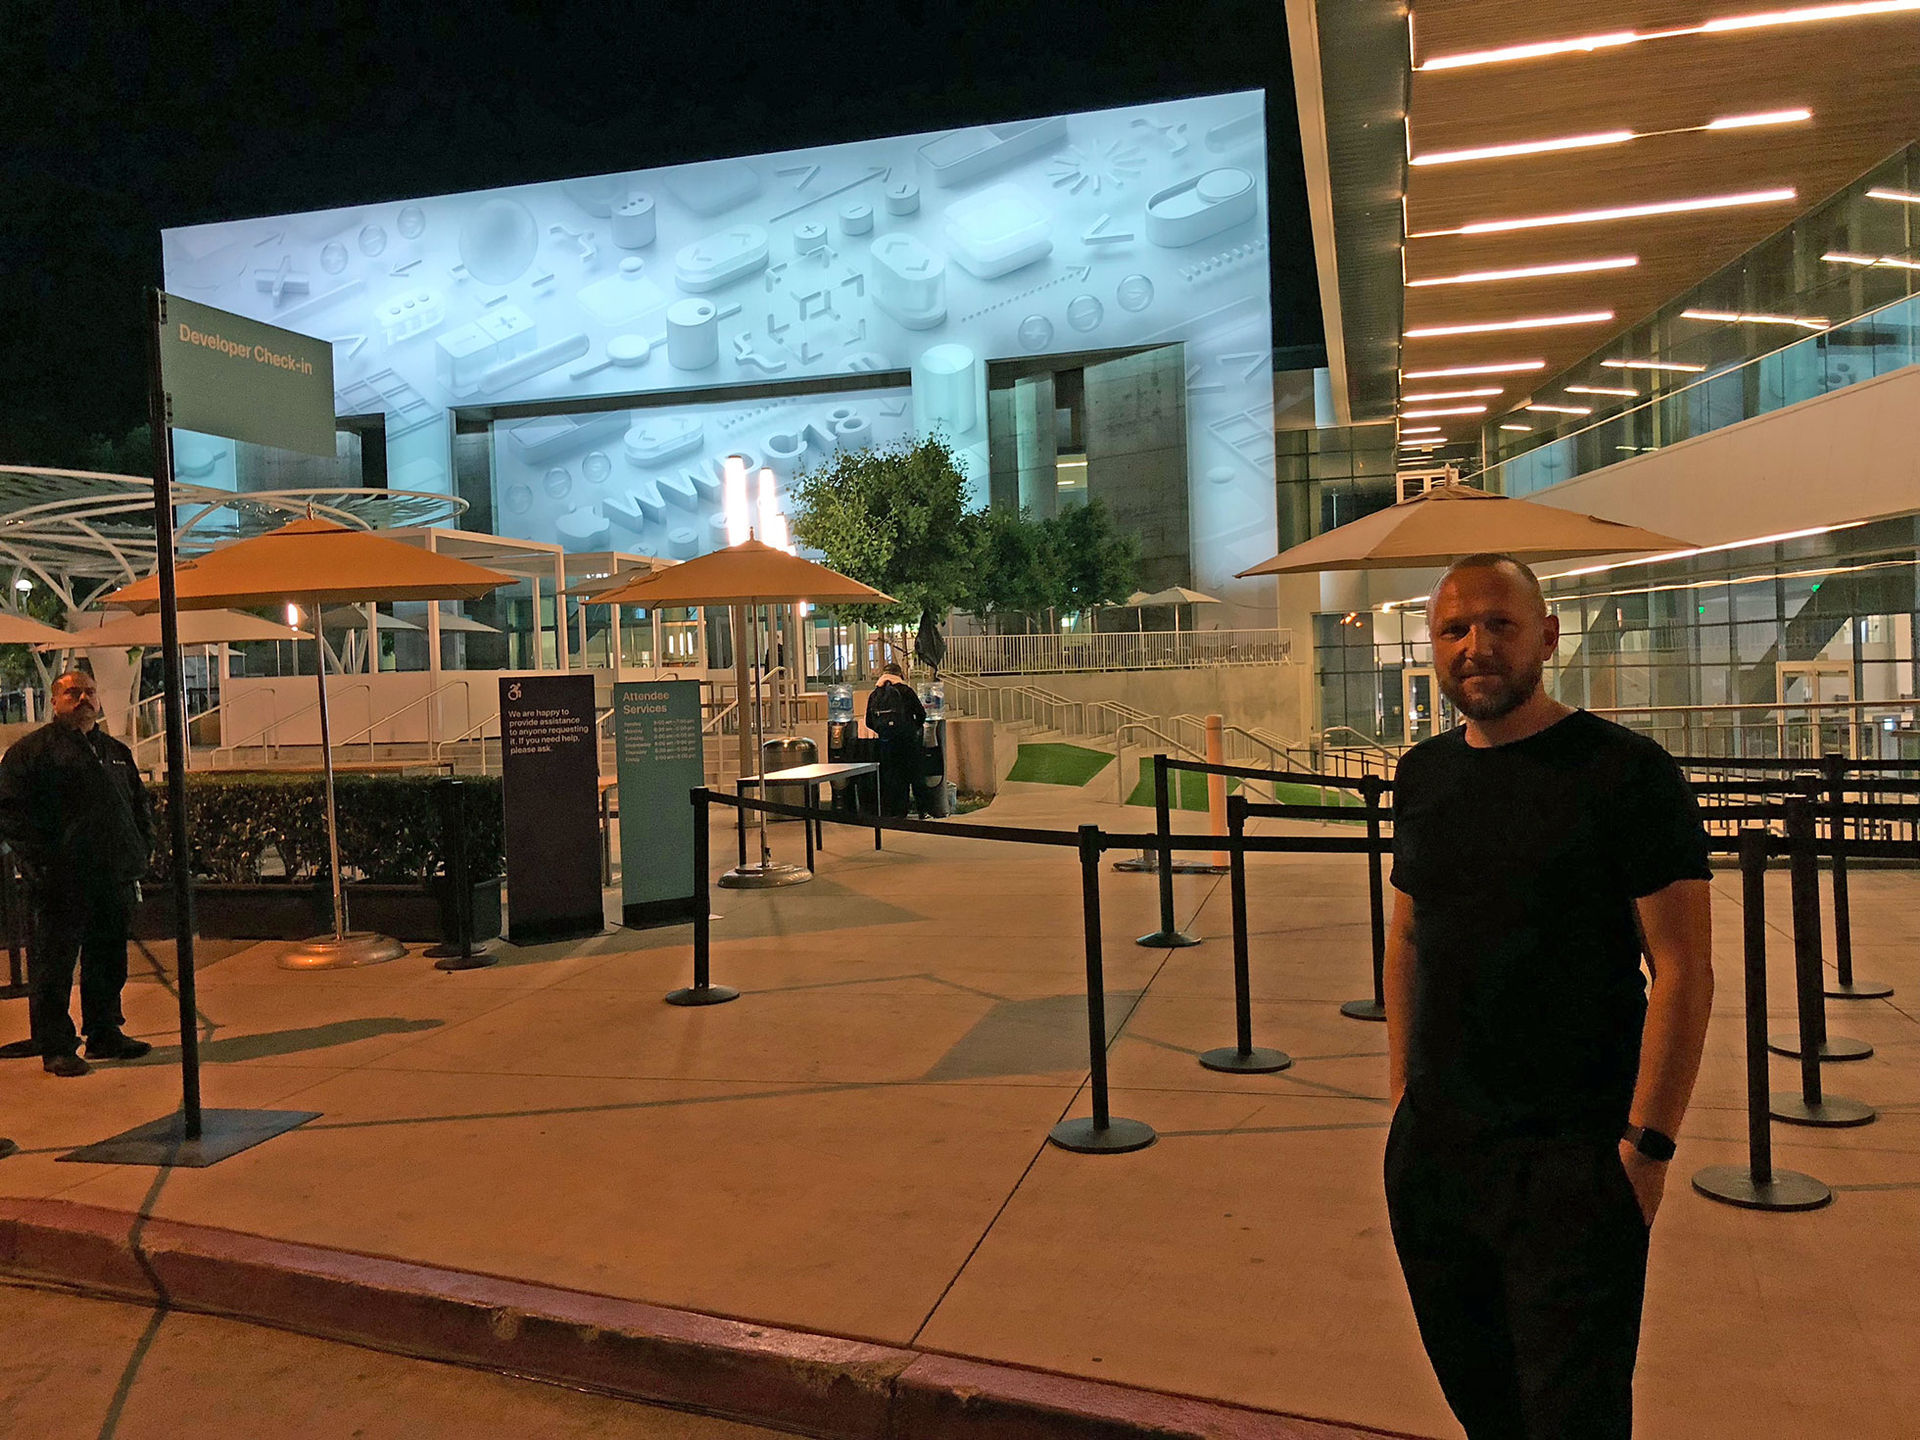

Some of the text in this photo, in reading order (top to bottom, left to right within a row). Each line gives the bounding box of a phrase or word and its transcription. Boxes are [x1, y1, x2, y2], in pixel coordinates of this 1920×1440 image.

[179, 323, 312, 375] Developer Check-in
[623, 691, 670, 702] Attendee
[536, 709, 560, 717] happy
[623, 704, 668, 714] Services
[509, 717, 581, 728] provide assistance
[519, 728, 547, 736] anyone
[548, 726, 589, 734] requesting
[525, 737, 540, 746] you
[541, 735, 561, 743] need
[562, 734, 581, 743] help,
[510, 746, 536, 755] please
